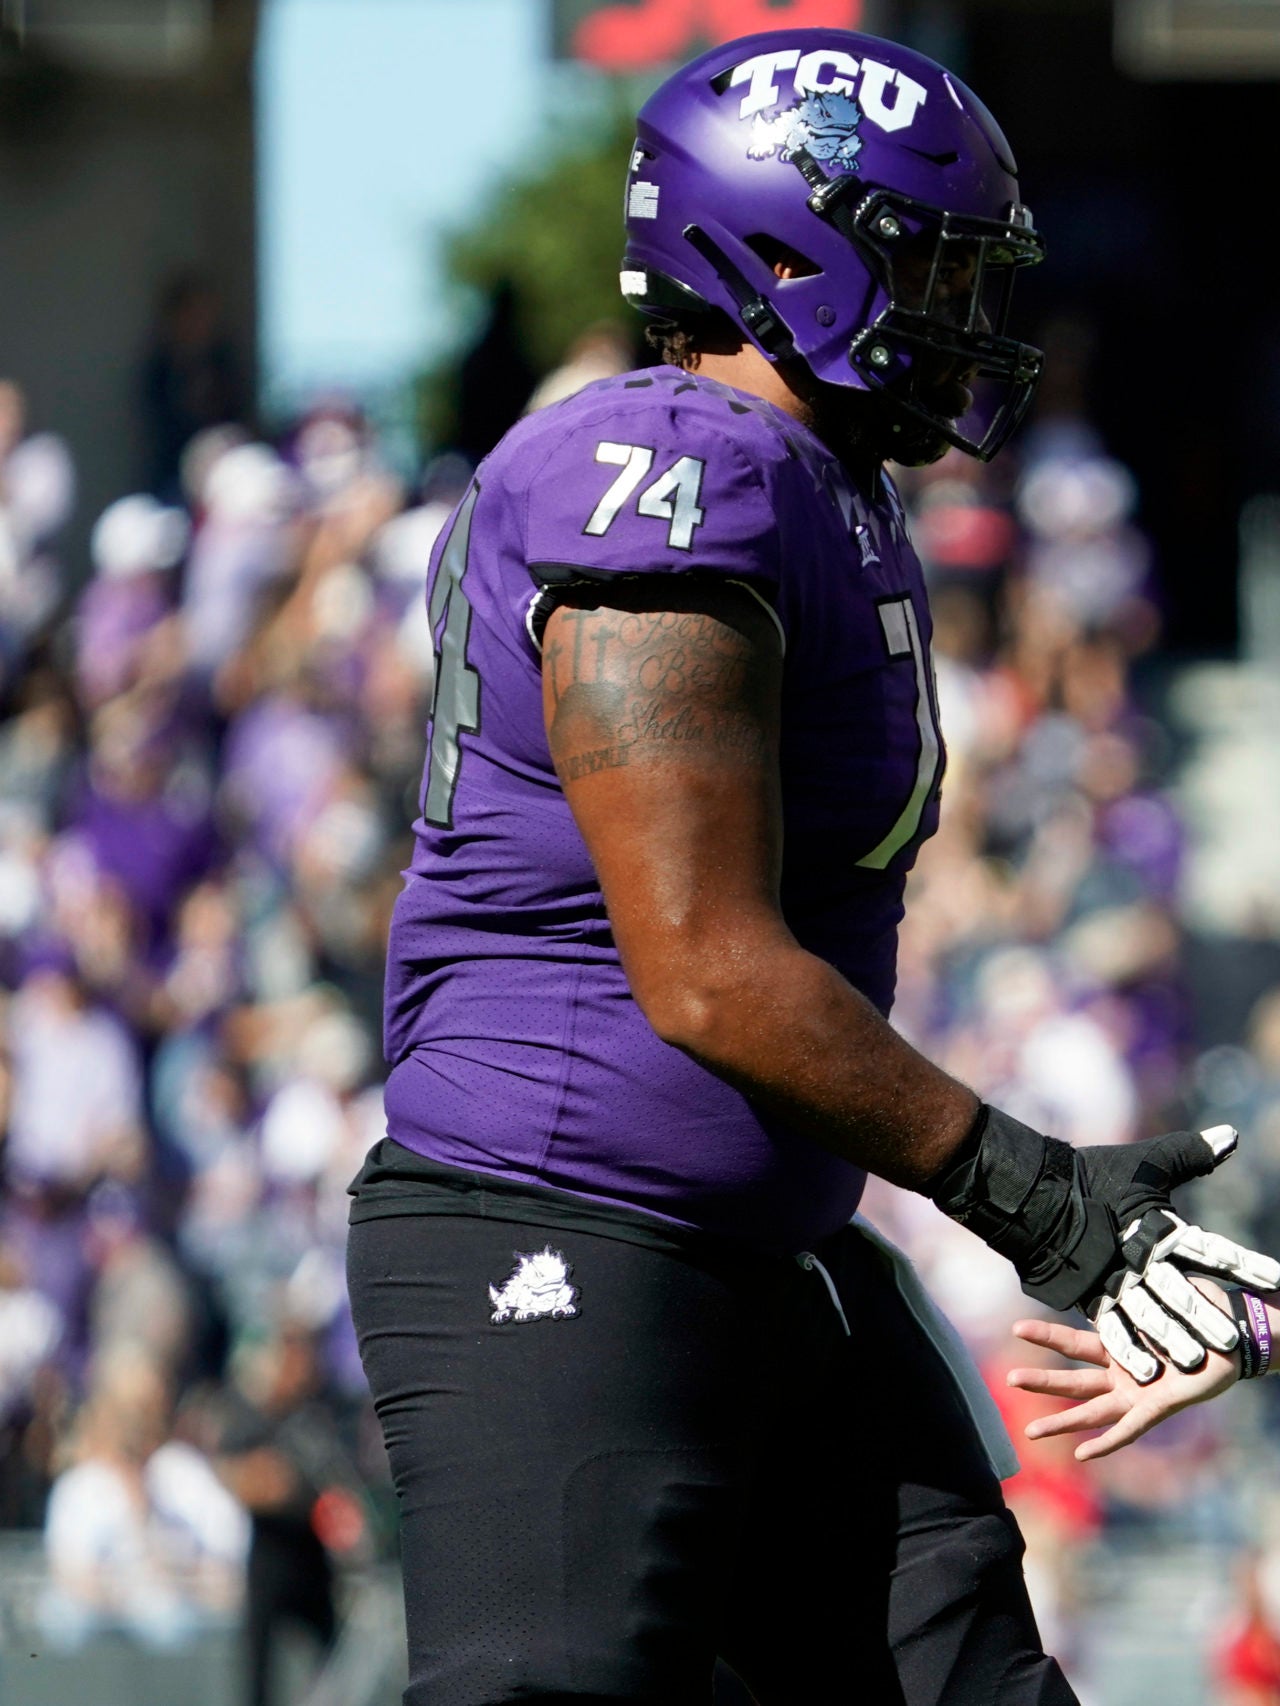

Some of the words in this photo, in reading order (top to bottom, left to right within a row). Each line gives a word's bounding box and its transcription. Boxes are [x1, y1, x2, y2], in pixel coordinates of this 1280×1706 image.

[731, 49, 927, 133] TCU
[582, 440, 706, 553] 74
[854, 591, 944, 870] 7
